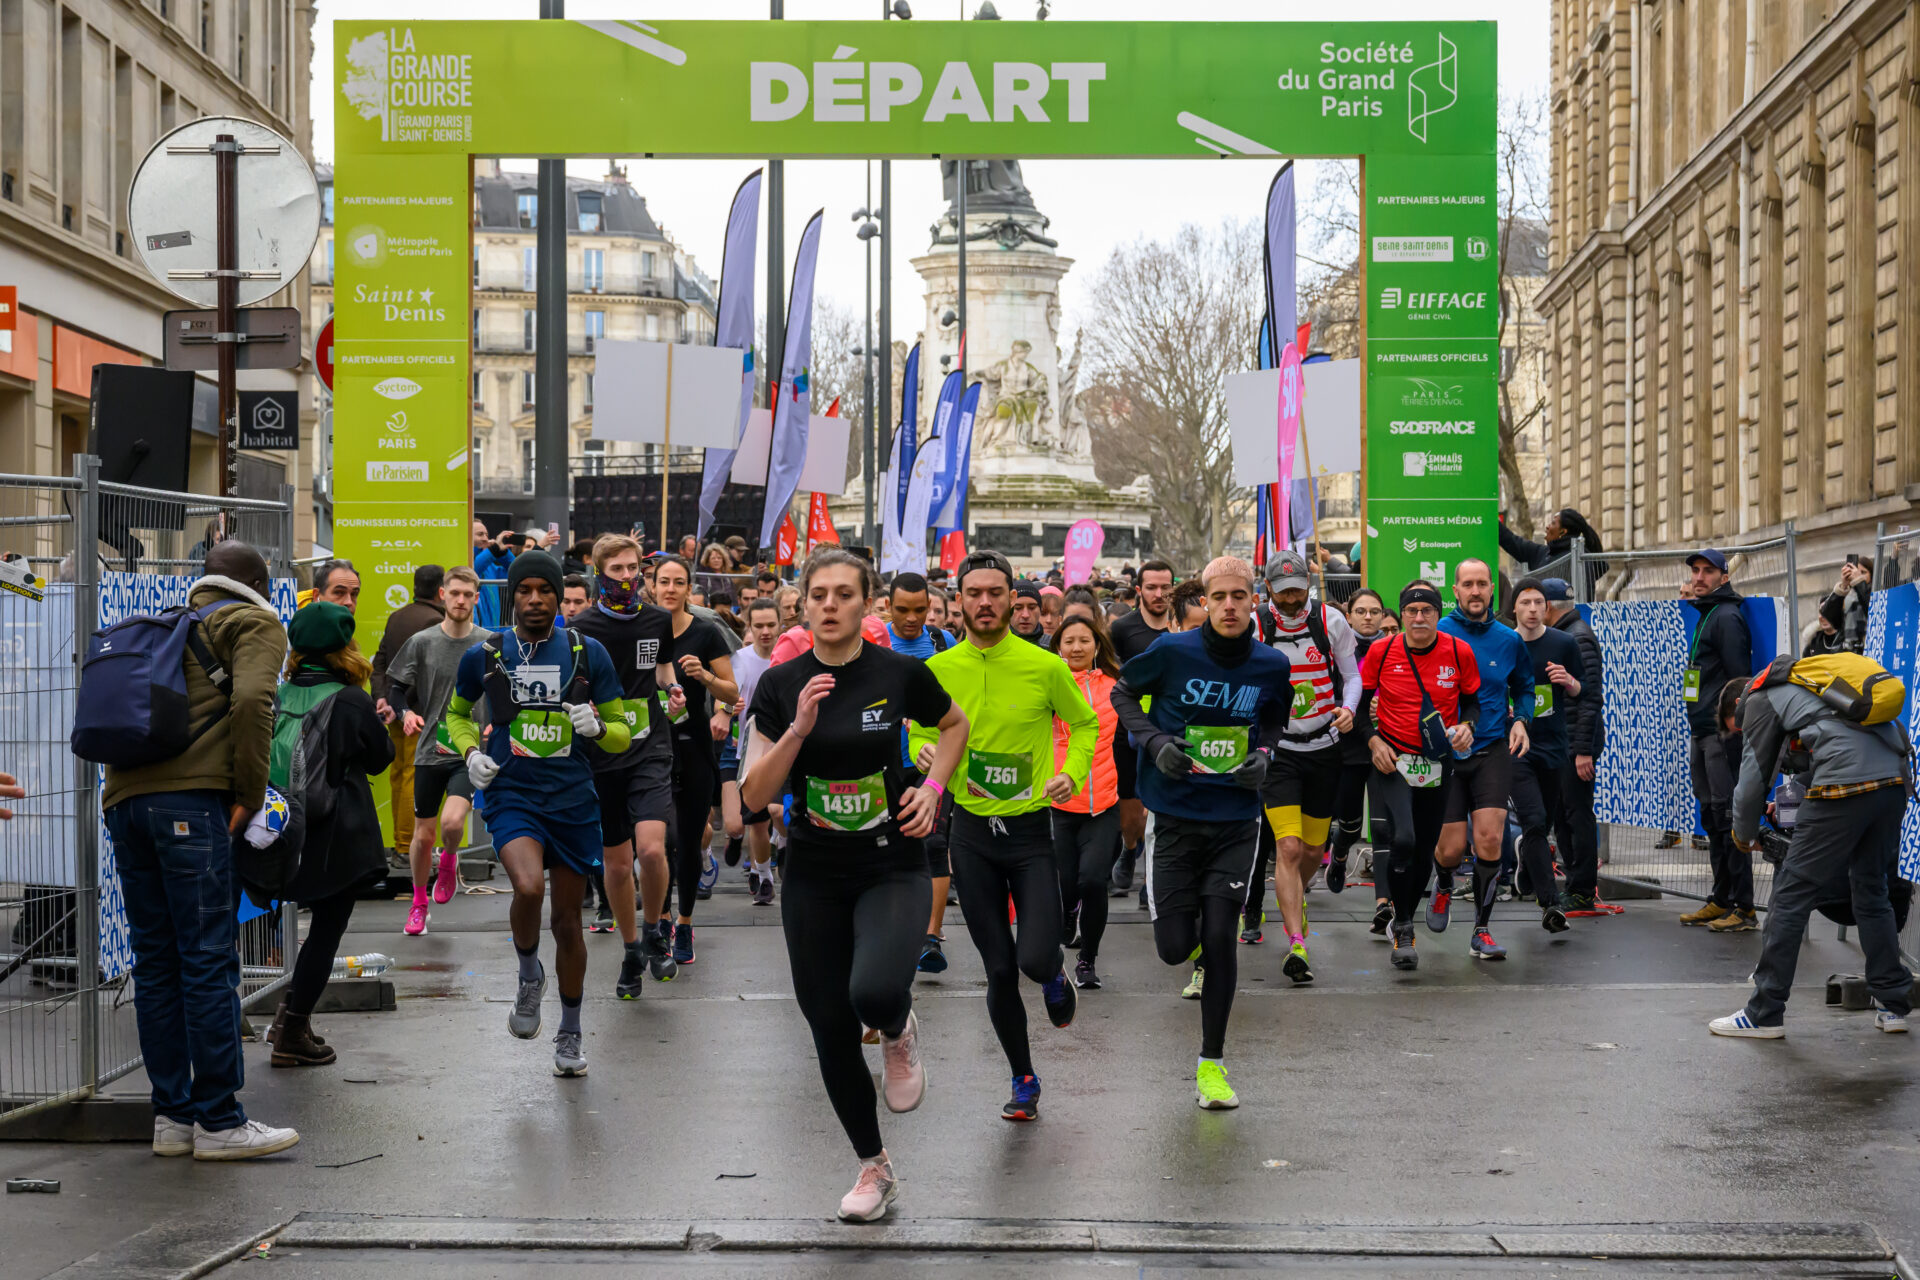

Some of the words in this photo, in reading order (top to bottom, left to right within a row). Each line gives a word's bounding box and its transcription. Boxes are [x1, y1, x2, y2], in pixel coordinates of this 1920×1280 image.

[391, 28, 415, 52] LA
[1320, 41, 1414, 63] Société
[391, 55, 472, 79] GRANDE
[750, 44, 1106, 122] DÉPART
[1278, 68, 1310, 90] du
[1318, 68, 1395, 90] Grand
[391, 82, 472, 106] COURSE
[1322, 96, 1383, 117] Paris
[399, 115, 431, 128] GRAND
[434, 115, 462, 128] PARIS
[399, 129, 462, 142] SAINT-DENIS
[343, 197, 406, 205] PARTENAIRES
[408, 197, 454, 205] MAJEURS
[1377, 196, 1439, 205] PARTENAIRES
[1441, 196, 1486, 205] MAJEURS
[387, 236, 438, 247] Métropole
[397, 247, 427, 257] Grand
[430, 247, 453, 257] Paris
[353, 283, 414, 303] Saint
[1407, 292, 1487, 308] EIFFAGE
[384, 304, 446, 321] Denis
[342, 356, 404, 364] PARTENAIRES
[407, 356, 455, 364] OFFICIELS
[1377, 354, 1438, 362] PARTENAIRES
[1440, 354, 1488, 362] OFFICIELS
[378, 384, 418, 394] syctom
[243, 432, 294, 447] habitat
[378, 438, 417, 448] PARIS
[336, 519, 407, 527] FOURNISSEURS
[409, 519, 458, 527] OFFICIELS
[1383, 516, 1445, 525] PARTENAIRES
[1447, 515, 1483, 525] MÉDIAS
[371, 540, 422, 548] DACIA
[1420, 541, 1462, 550] Ecolosport
[862, 709, 883, 723] EY
[521, 723, 562, 742] 10651
[1201, 740, 1235, 757] 6675
[984, 766, 1018, 785] 7361
[821, 792, 870, 814] 14317
